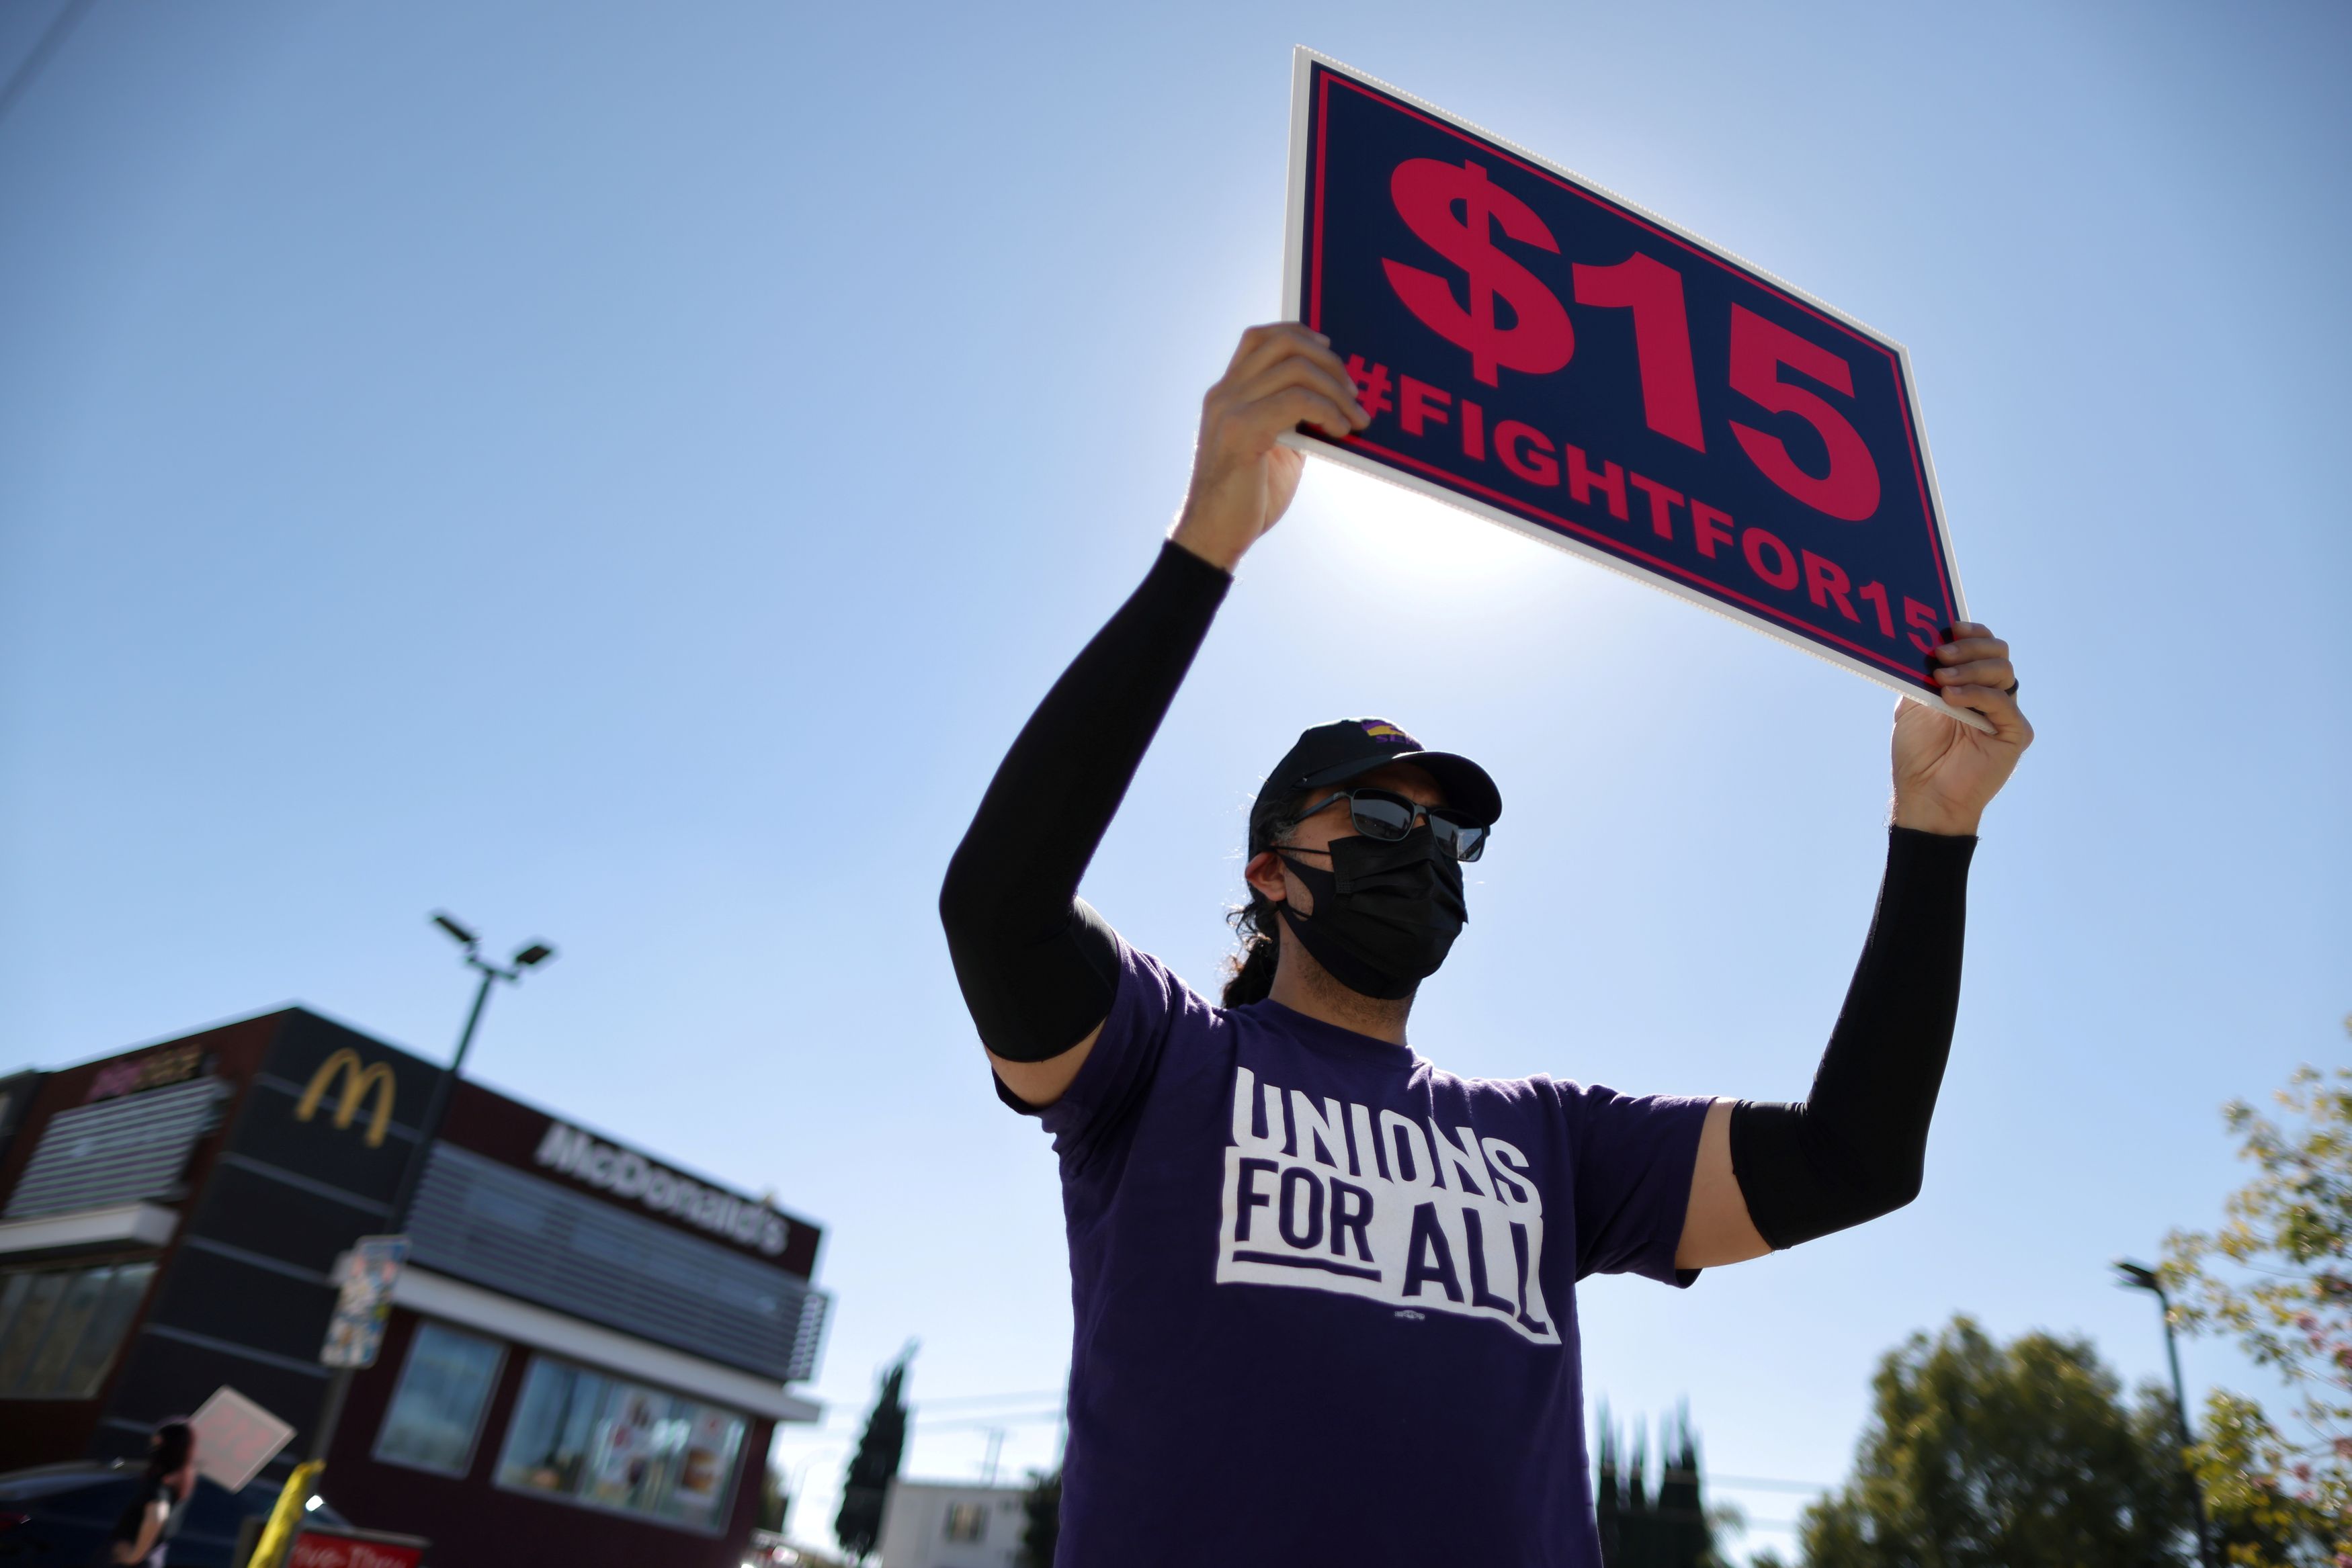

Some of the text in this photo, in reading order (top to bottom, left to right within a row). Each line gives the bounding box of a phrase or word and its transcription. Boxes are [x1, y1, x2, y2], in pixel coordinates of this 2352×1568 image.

[1380, 156, 1882, 523] $15
[1344, 353, 1945, 658] #FIGHTFOR15
[536, 1121, 790, 1256] McDonald's
[1232, 1065, 1542, 1213] UNIONS
[1234, 1157, 1550, 1336] FOR ALL
